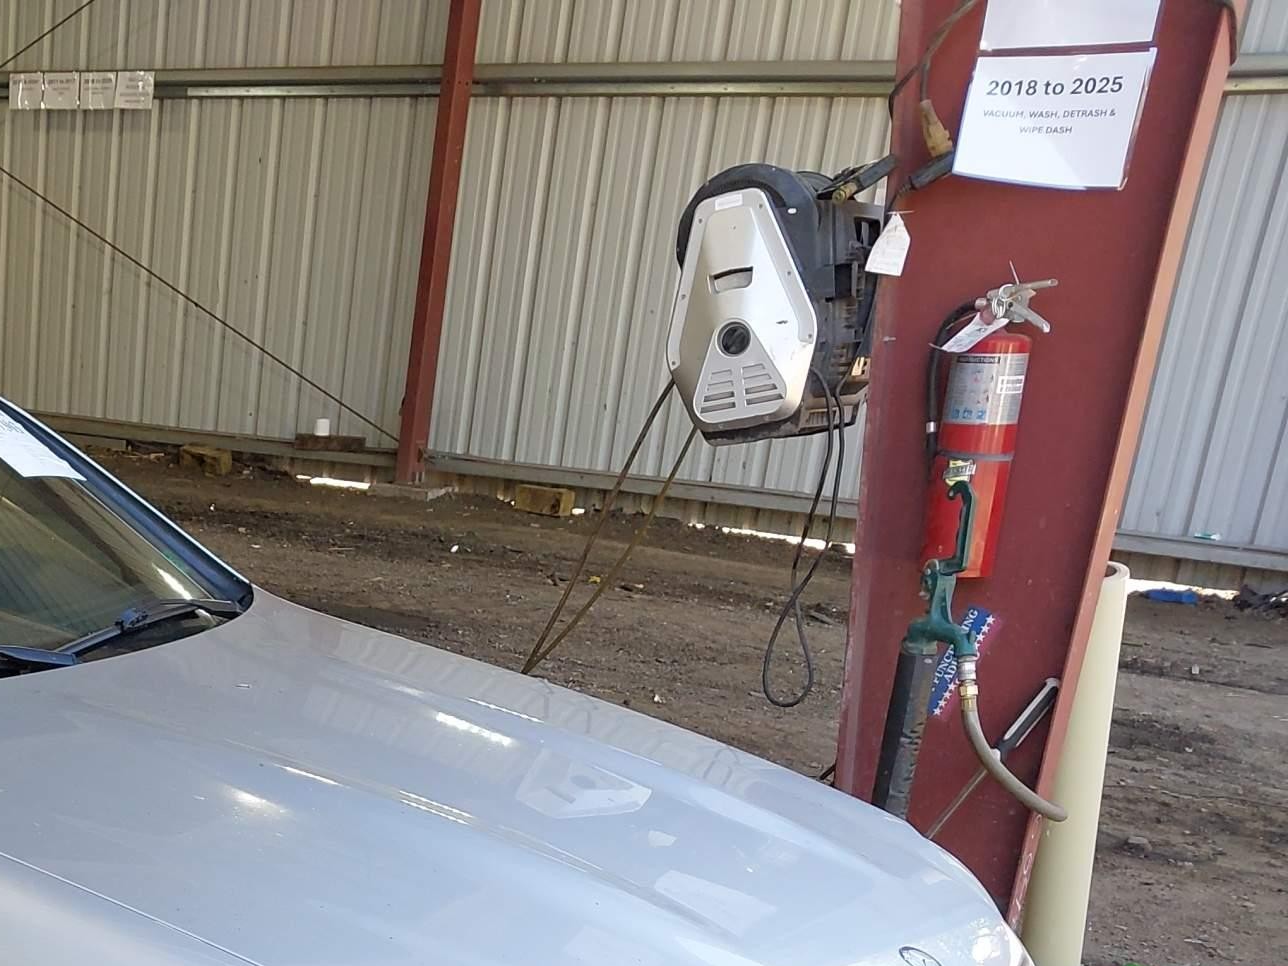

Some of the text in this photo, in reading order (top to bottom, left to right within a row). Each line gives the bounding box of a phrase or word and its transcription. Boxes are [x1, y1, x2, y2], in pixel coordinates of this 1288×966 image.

[986, 76, 1124, 96] 2018 to 2025
[1029, 110, 1060, 119] WASH,
[1063, 109, 1107, 118] DETRASH
[1019, 126, 1072, 134] WIPE DASH
